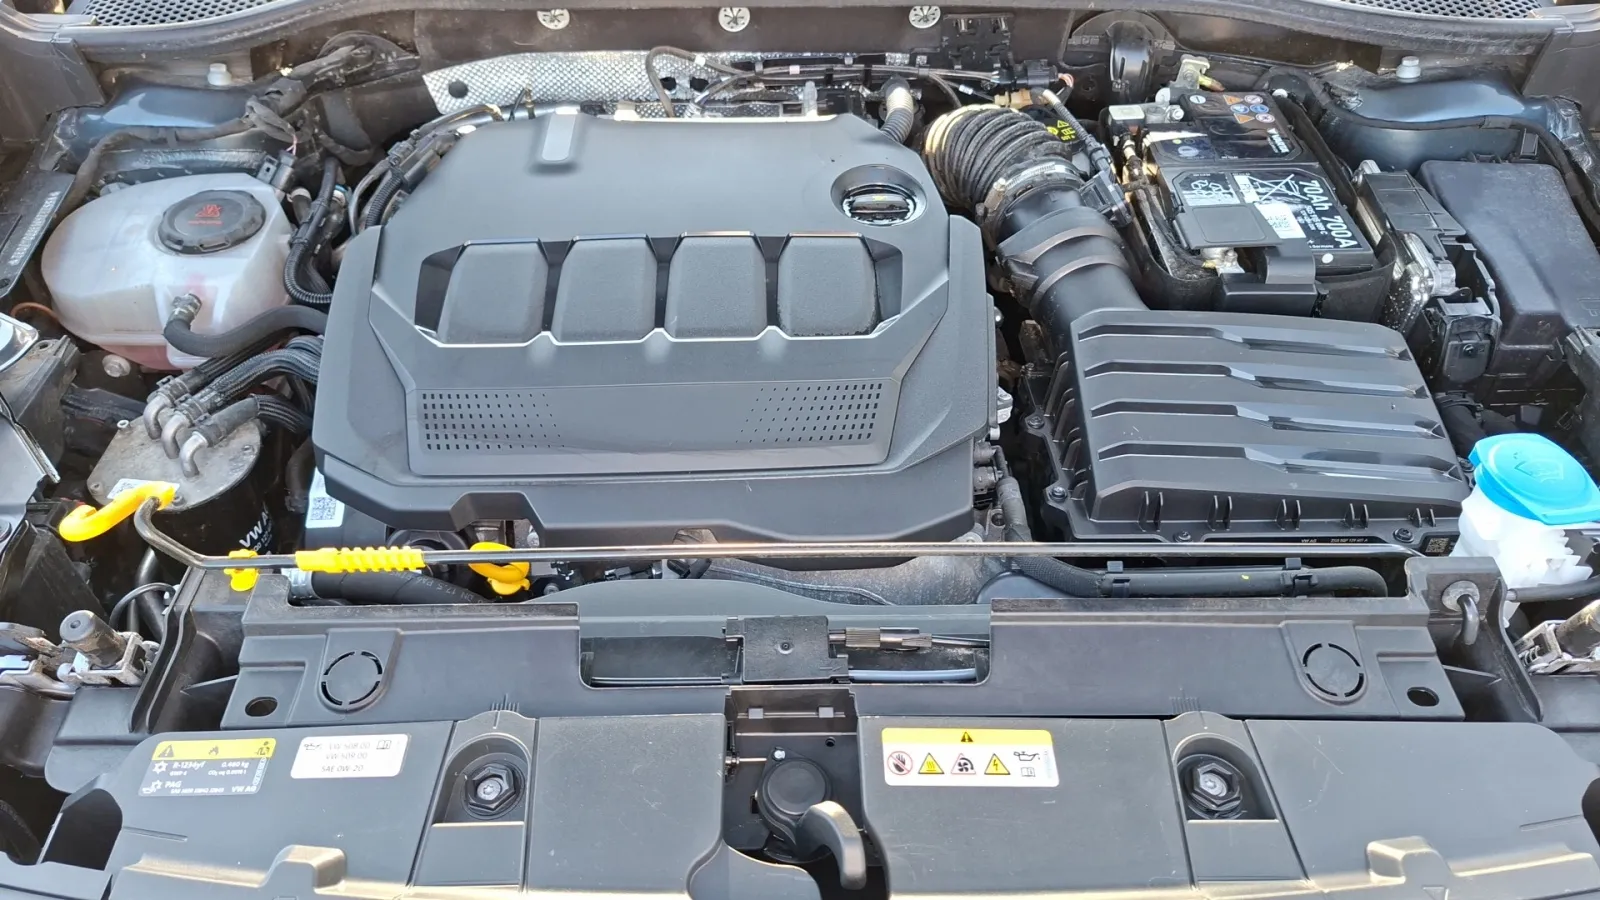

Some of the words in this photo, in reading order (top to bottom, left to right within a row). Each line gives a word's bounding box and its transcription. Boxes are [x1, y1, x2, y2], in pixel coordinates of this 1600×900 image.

[1299, 180, 1333, 211] 70Ah
[1321, 215, 1358, 248] 700A
[239, 521, 262, 547] VW
[172, 760, 207, 770] R-1234yf
[321, 765, 335, 773] SAE
[165, 780, 183, 788] PAG
